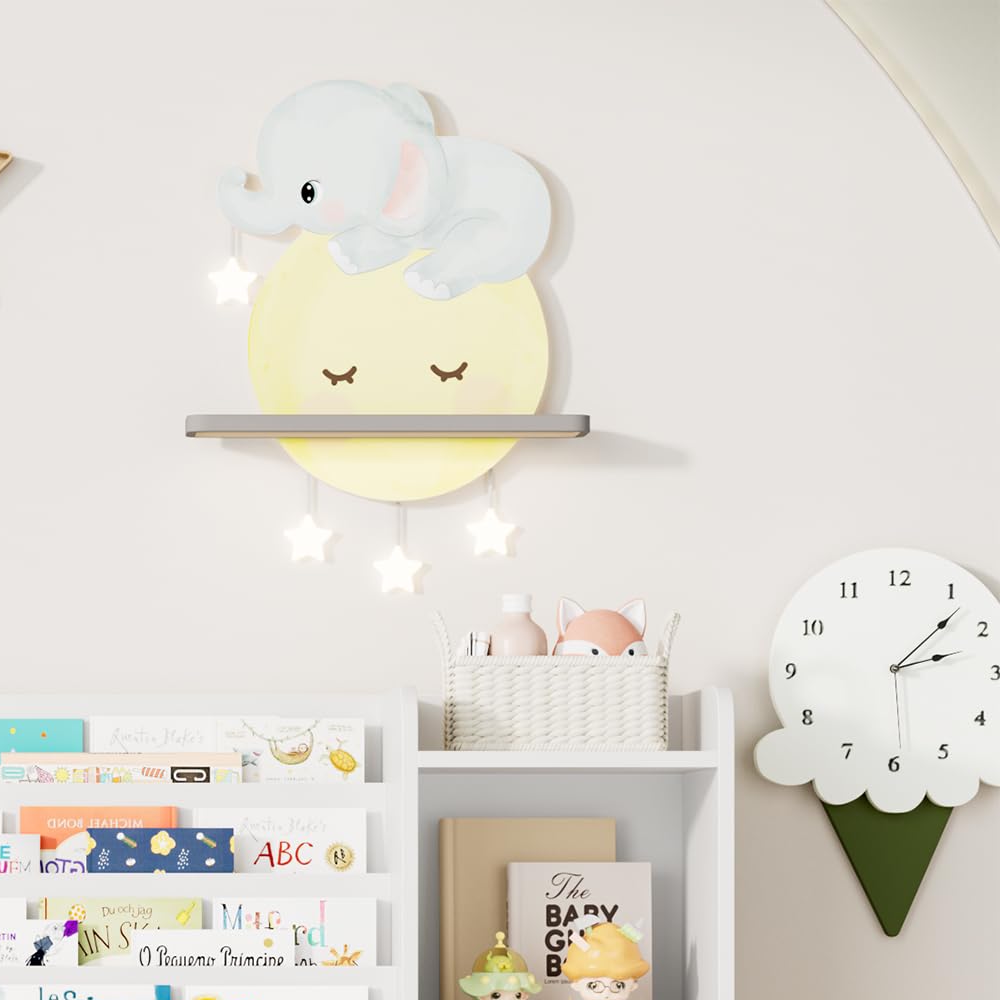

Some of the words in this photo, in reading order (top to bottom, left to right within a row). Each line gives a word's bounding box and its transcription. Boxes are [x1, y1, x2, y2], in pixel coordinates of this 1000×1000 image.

[889, 570, 911, 586] 12
[840, 582, 858, 599] 11
[948, 584, 955, 599] 1
[802, 619, 823, 636] 10
[977, 621, 988, 637] 2
[785, 663, 797, 679] 9
[990, 665, 1000, 681] 3
[802, 709, 813, 725] 8
[974, 710, 986, 726] 4
[841, 743, 853, 759] 7
[938, 744, 949, 759] 5
[888, 755, 900, 772] 6
[253, 841, 313, 868] ABC
[545, 872, 591, 900] The
[102, 906, 115, 917] Du
[117, 904, 134, 914] och
[132, 907, 153, 919] jag
